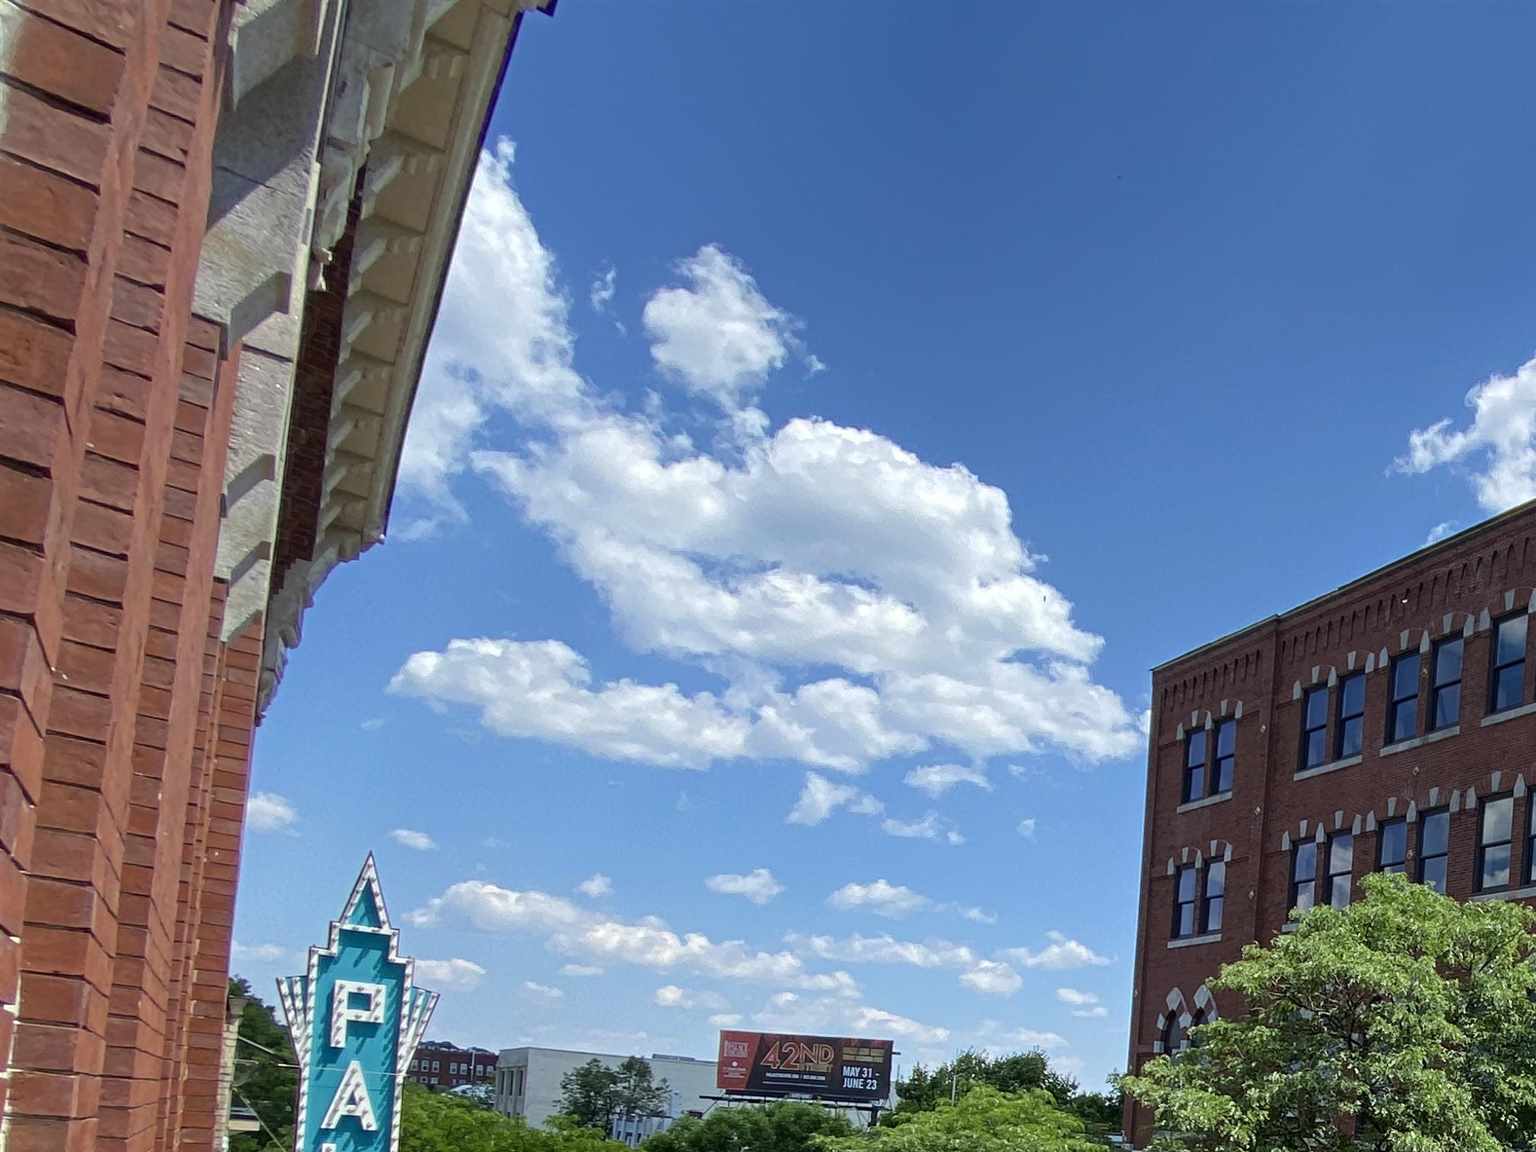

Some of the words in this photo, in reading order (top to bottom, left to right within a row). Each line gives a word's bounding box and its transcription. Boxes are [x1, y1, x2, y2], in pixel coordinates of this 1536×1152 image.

[760, 1040, 835, 1071] 42ND
[842, 1065, 861, 1078] MAY
[861, 1067, 873, 1078] 31
[842, 1078, 864, 1089] JUNE
[866, 1079, 878, 1090] 23
